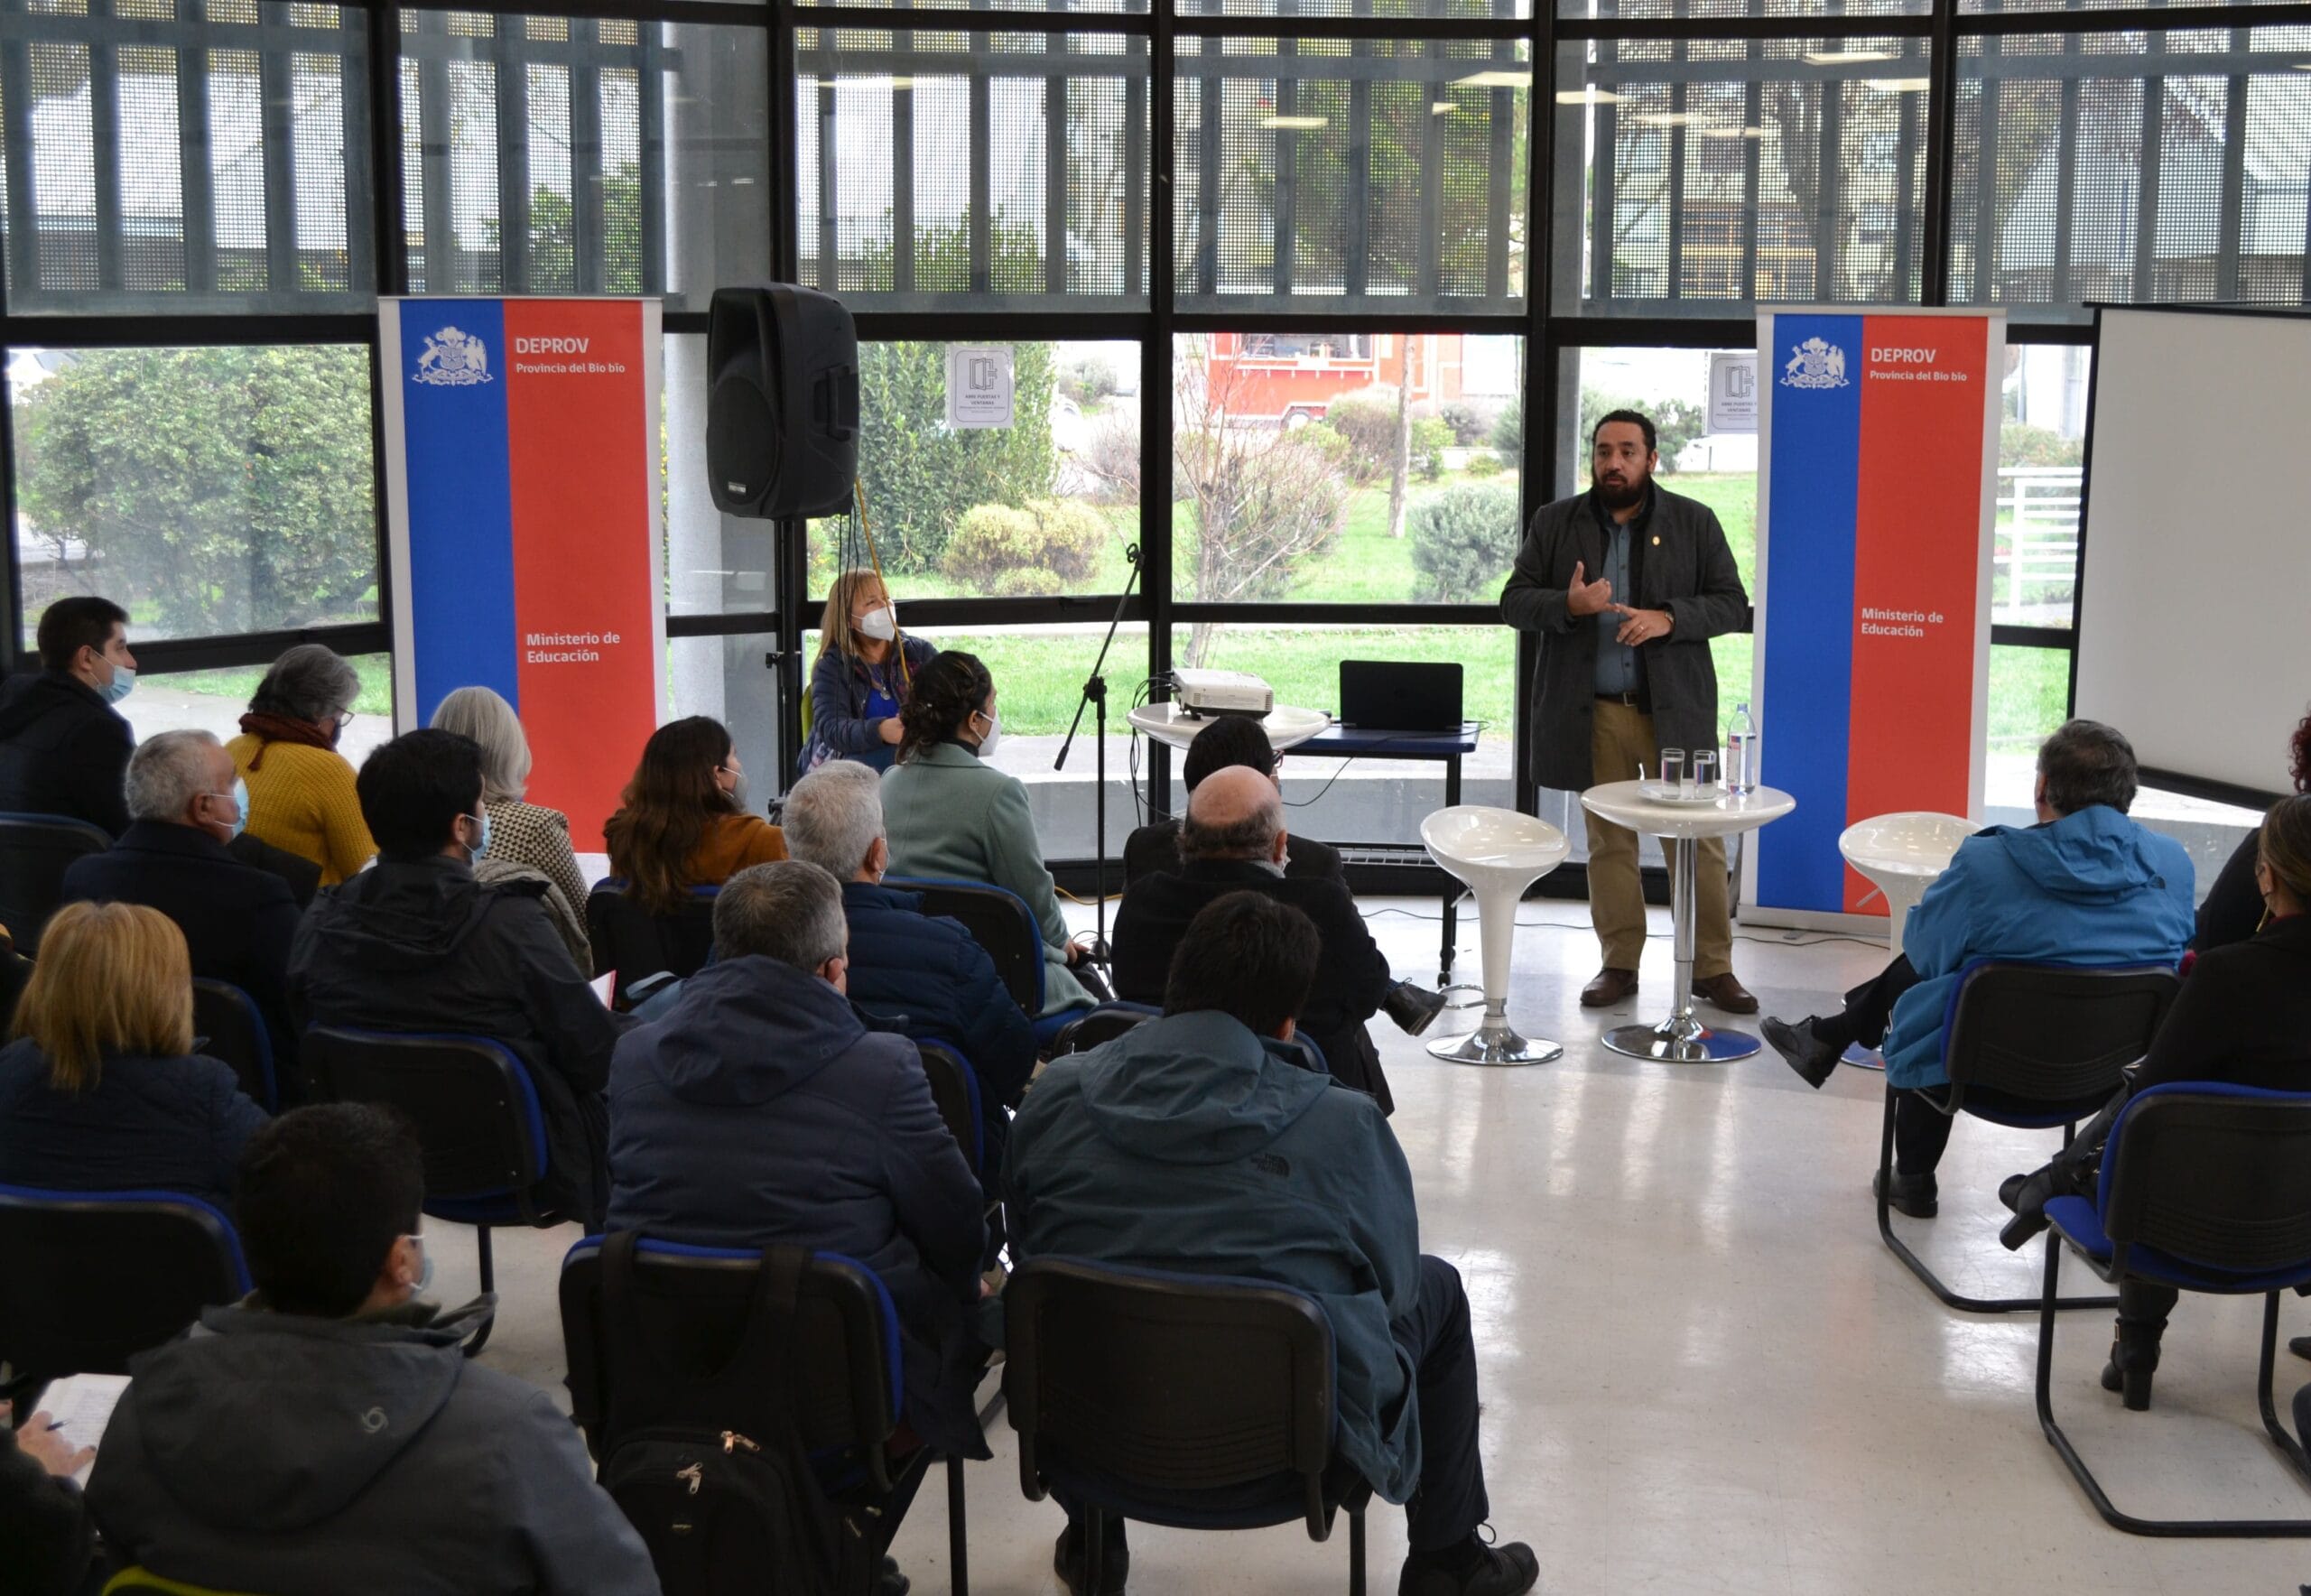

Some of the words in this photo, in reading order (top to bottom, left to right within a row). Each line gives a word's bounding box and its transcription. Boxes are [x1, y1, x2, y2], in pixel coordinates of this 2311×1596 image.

[515, 337, 589, 354] DEPROV
[1870, 348, 1936, 363] DEPROV
[516, 363, 566, 373] Provincia
[569, 363, 586, 373] del
[1870, 370, 1914, 380] Provincia
[1916, 371, 1931, 380] del
[1861, 608, 1925, 622] Ministerio
[1927, 611, 1944, 623] de
[1861, 622, 1924, 637] Educación
[526, 632, 599, 646] Ministerio
[603, 631, 620, 644] de
[527, 649, 599, 663] Educación
